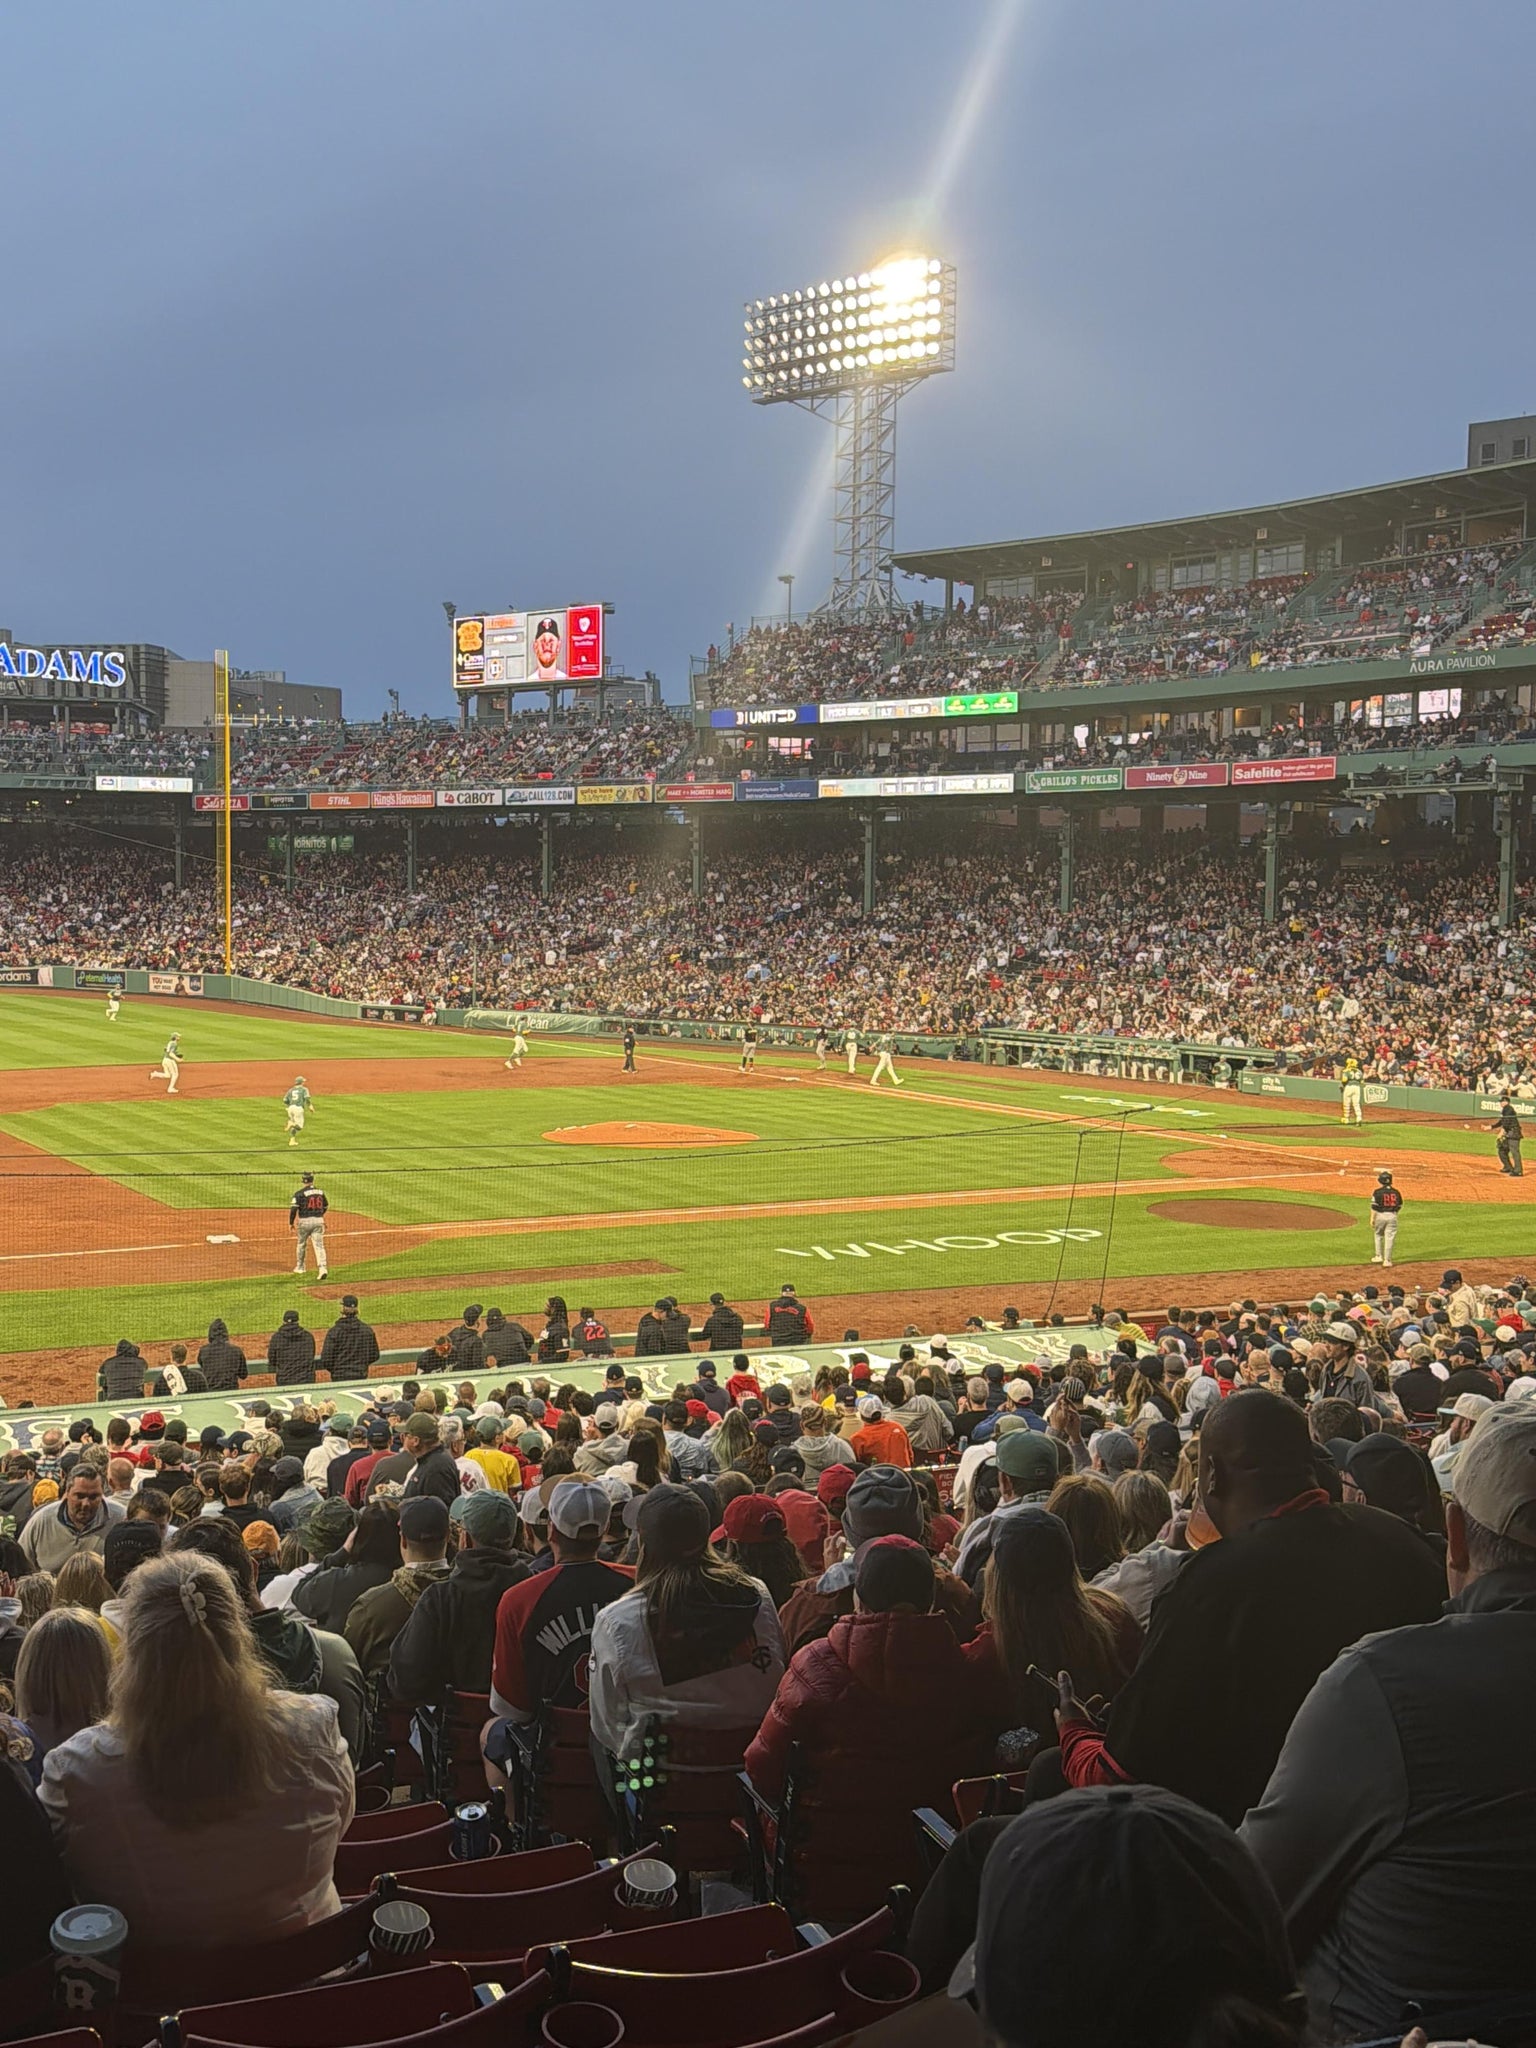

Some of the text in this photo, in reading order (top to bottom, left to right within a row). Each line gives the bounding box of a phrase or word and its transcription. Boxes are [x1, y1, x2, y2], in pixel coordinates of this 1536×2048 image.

[0, 642, 126, 688] ADAMS
[1446, 654, 1496, 670] PAVILION
[749, 709, 797, 724] UNITED
[1080, 773, 1118, 785] PICKLES
[1146, 772, 1173, 783] Ninety
[1188, 770, 1208, 780] Nine
[1234, 766, 1282, 780] Safelite
[327, 796, 352, 805] STIHL
[396, 792, 432, 806] Hawaiian
[527, 790, 573, 801] CALL128.COM
[774, 1228, 1103, 1261] WHOOP
[583, 1324, 607, 1342] 22
